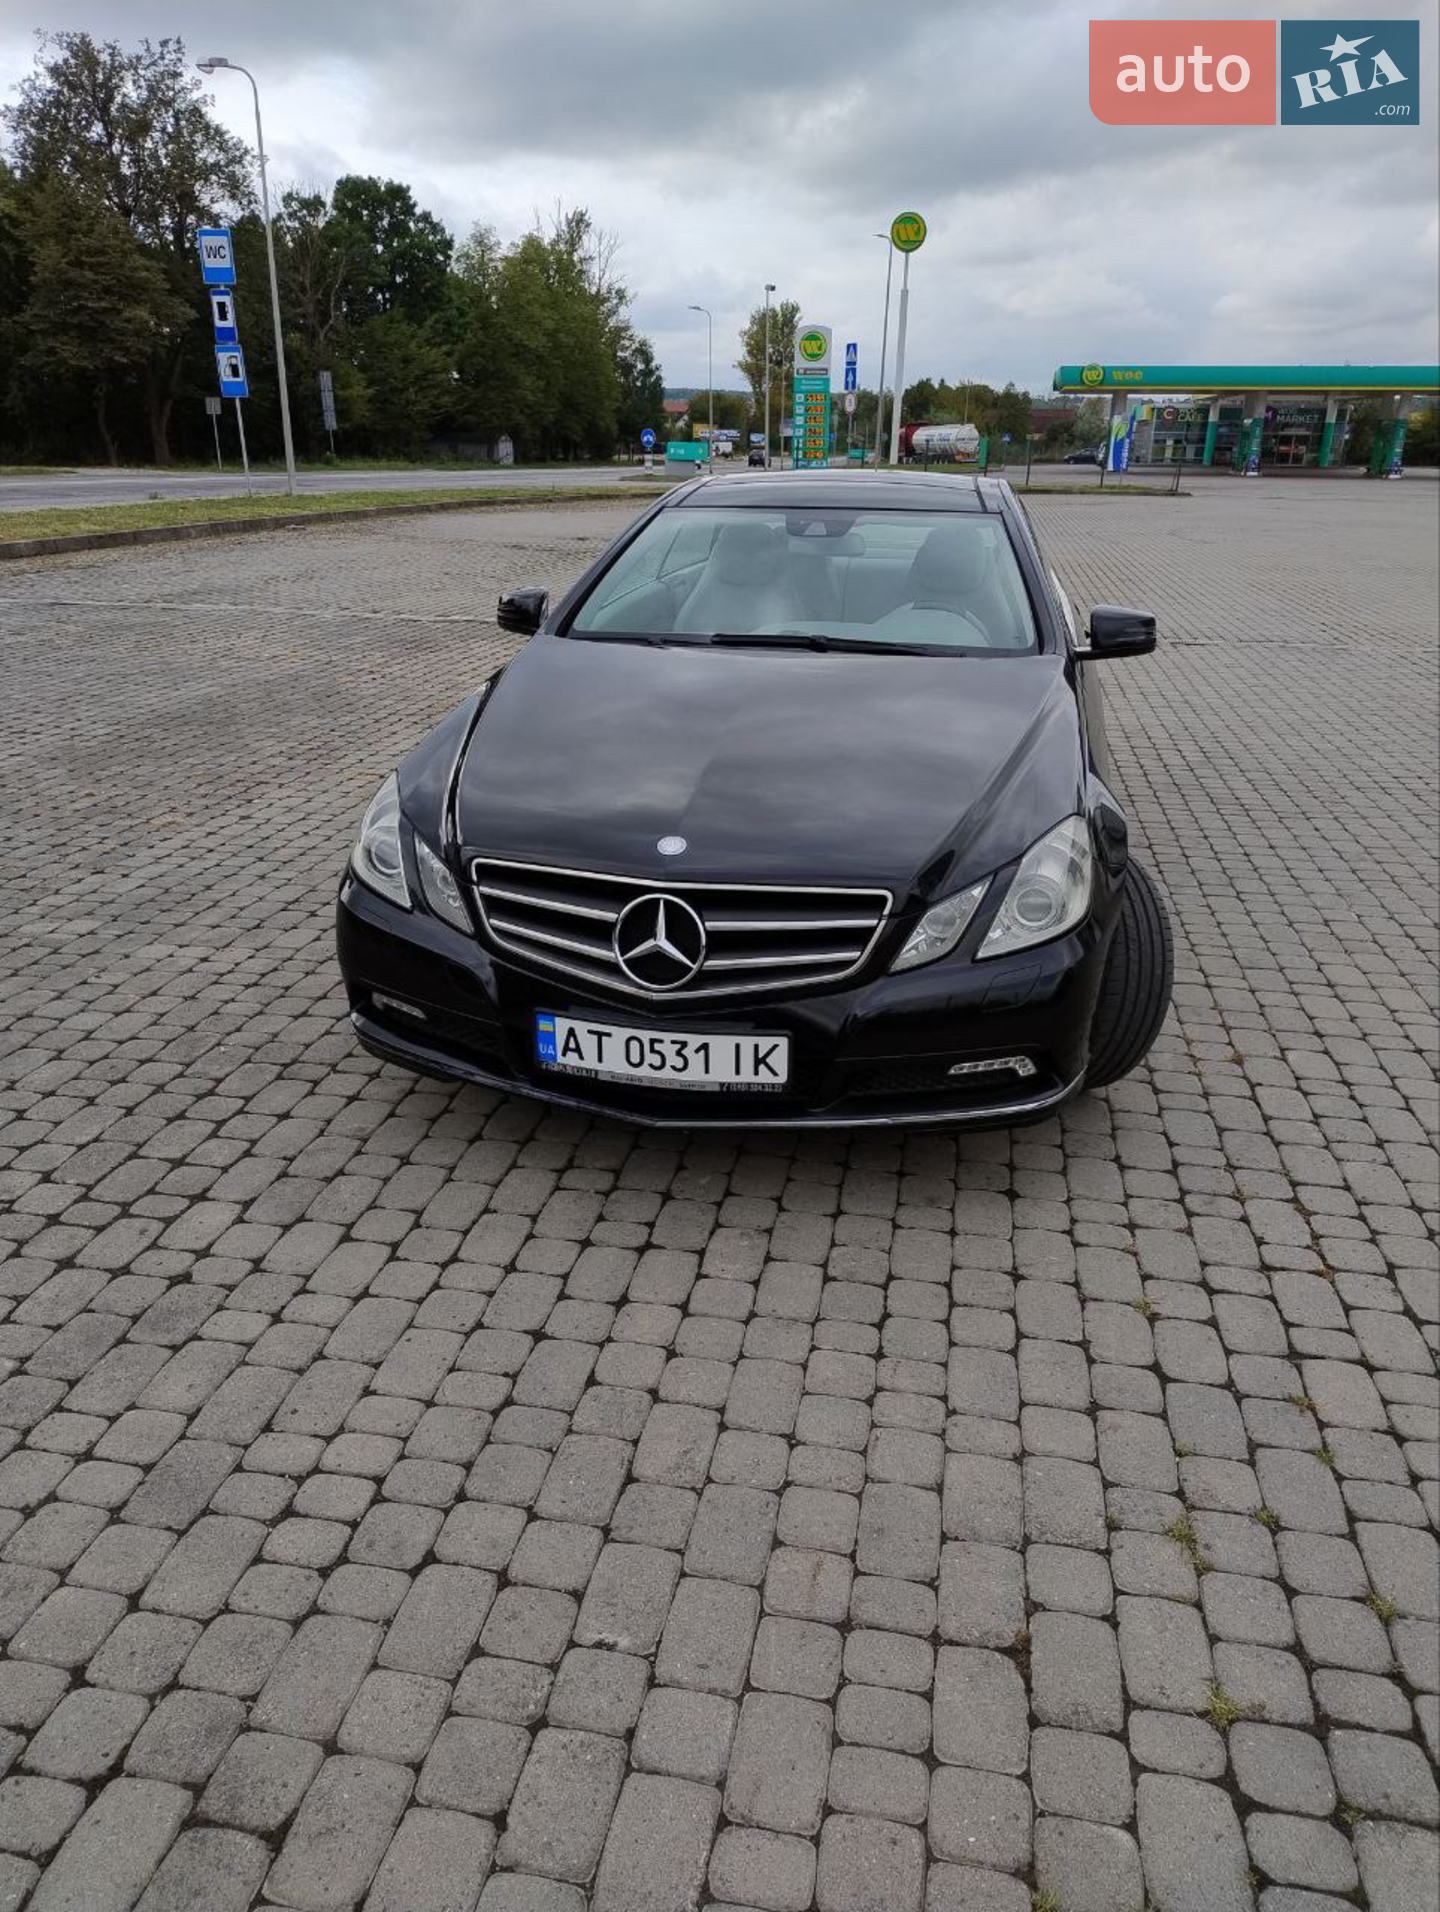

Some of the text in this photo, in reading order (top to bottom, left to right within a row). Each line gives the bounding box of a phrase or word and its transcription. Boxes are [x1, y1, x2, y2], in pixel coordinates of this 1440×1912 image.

[205, 245, 227, 260] WC
[1276, 414, 1320, 423] MARKET
[540, 1043, 555, 1056] UA
[561, 1026, 612, 1064] AT
[624, 1035, 710, 1075] 0531
[734, 1042, 780, 1077] IK
